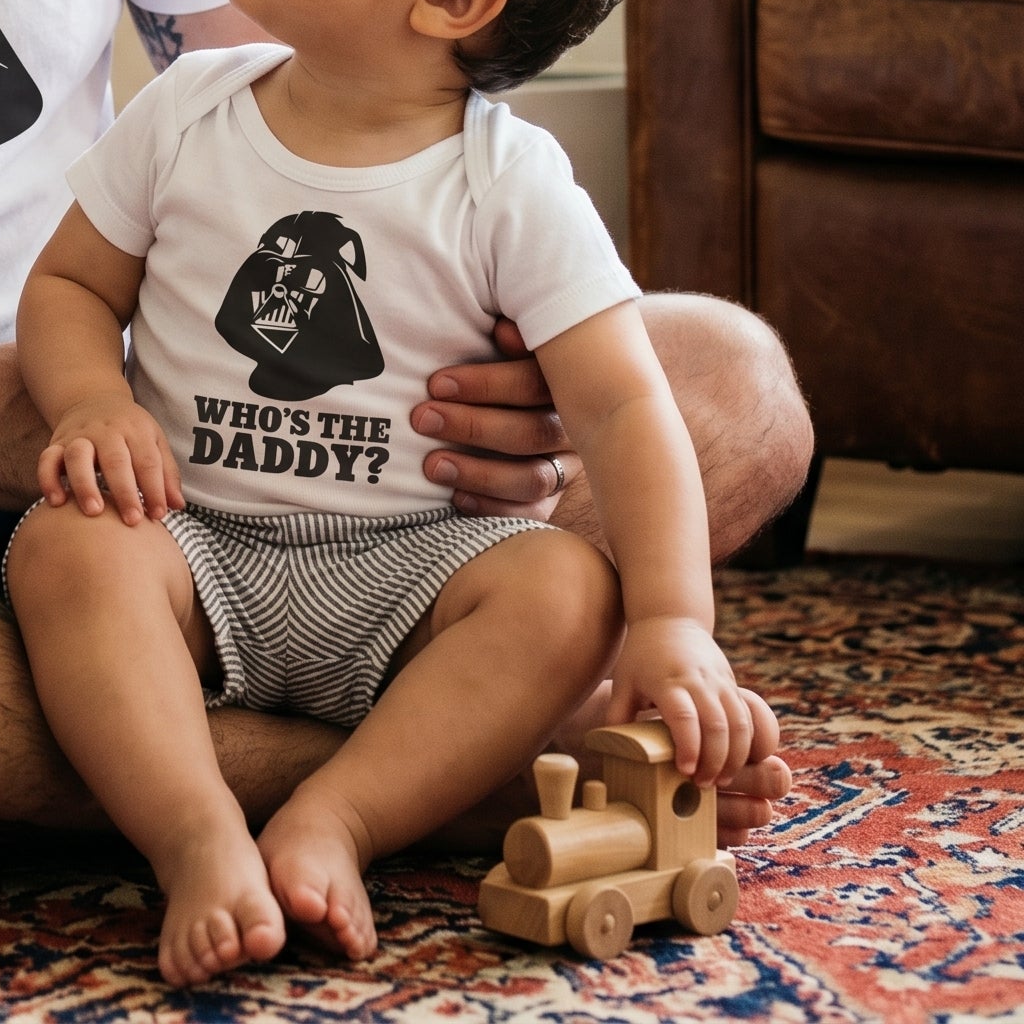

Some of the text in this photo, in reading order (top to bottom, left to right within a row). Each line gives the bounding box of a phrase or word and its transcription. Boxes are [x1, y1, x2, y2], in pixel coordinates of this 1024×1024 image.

[194, 395, 392, 444] WHO'S THE
[188, 426, 390, 484] DADDY?
